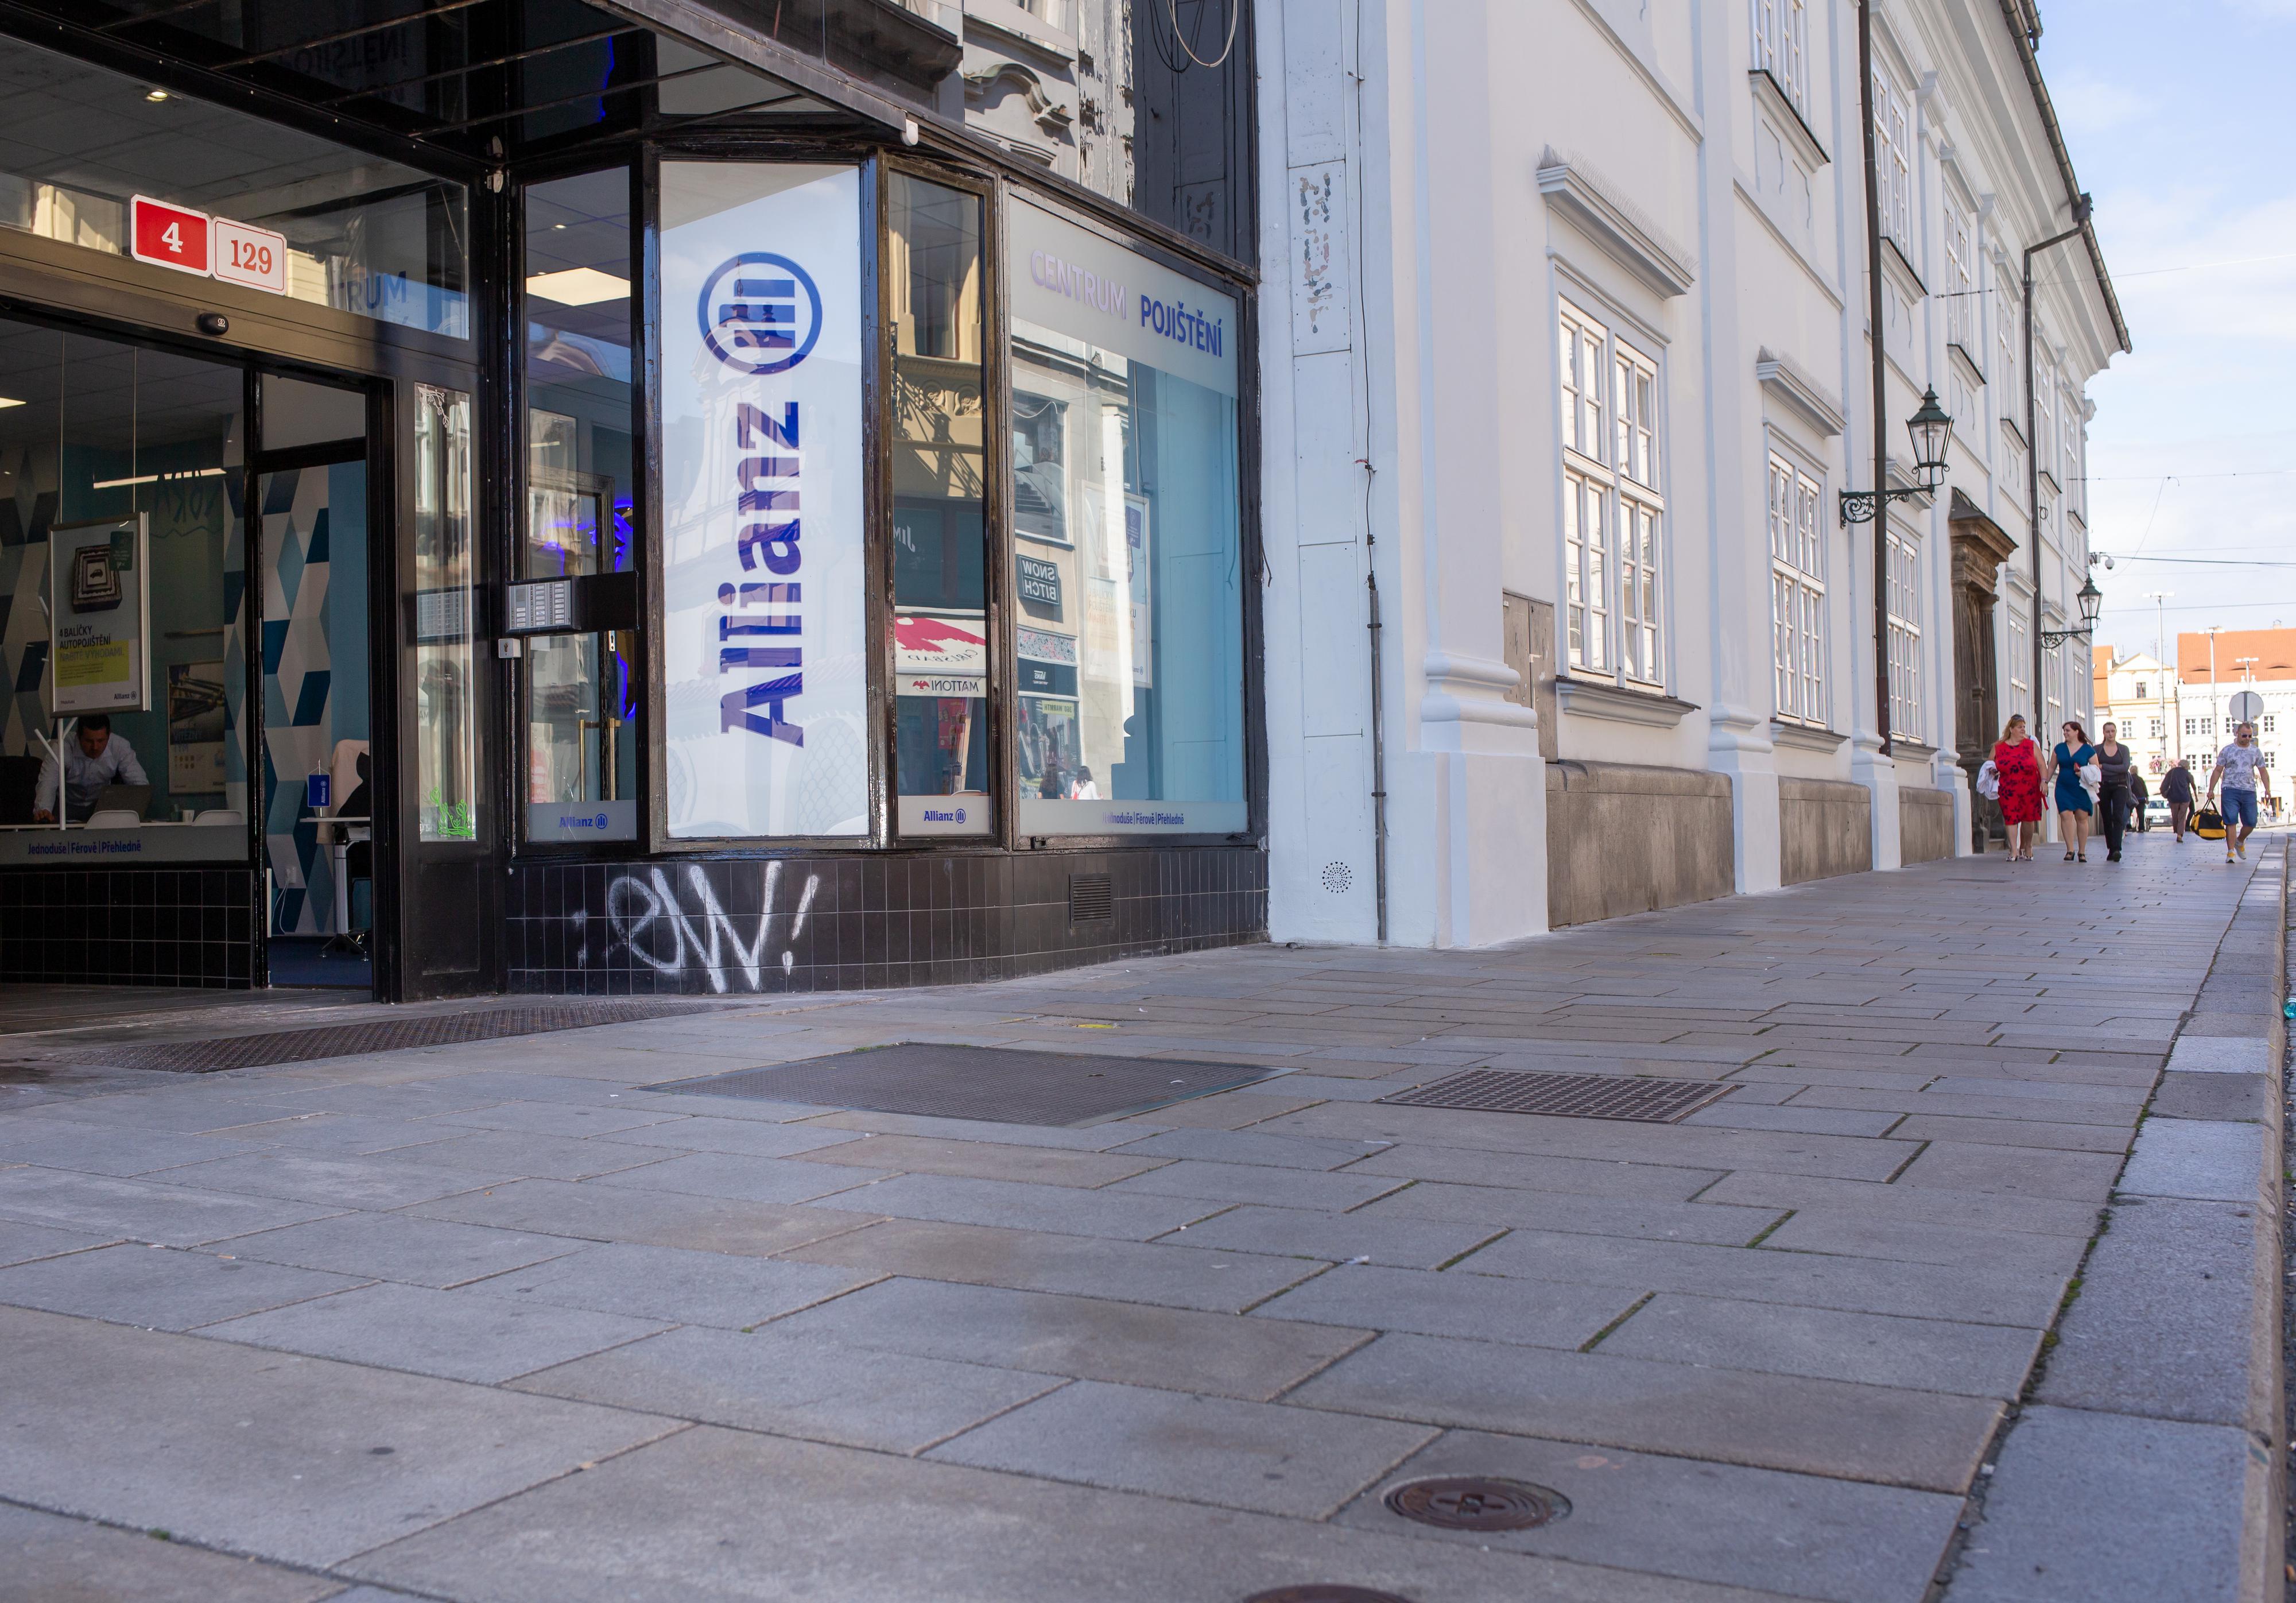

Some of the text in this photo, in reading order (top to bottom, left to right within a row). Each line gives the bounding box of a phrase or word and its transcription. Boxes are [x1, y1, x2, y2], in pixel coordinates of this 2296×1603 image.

[161, 222, 183, 253] 4
[231, 239, 272, 274] 129
[1031, 250, 1222, 358] CENTRUM POJIŠTĚNÍ
[718, 401, 804, 749] Allianz
[64, 624, 92, 637] BALÍČKY
[59, 633, 111, 650] AUTOPOJIŠTĚNÍ
[559, 816, 593, 827] Allianz
[924, 810, 954, 822] Allianz
[1136, 812, 1155, 825] Férově
[1157, 812, 1185, 825] Přehledně
[28, 839, 142, 855] Jednoduše Férově Přehledně
